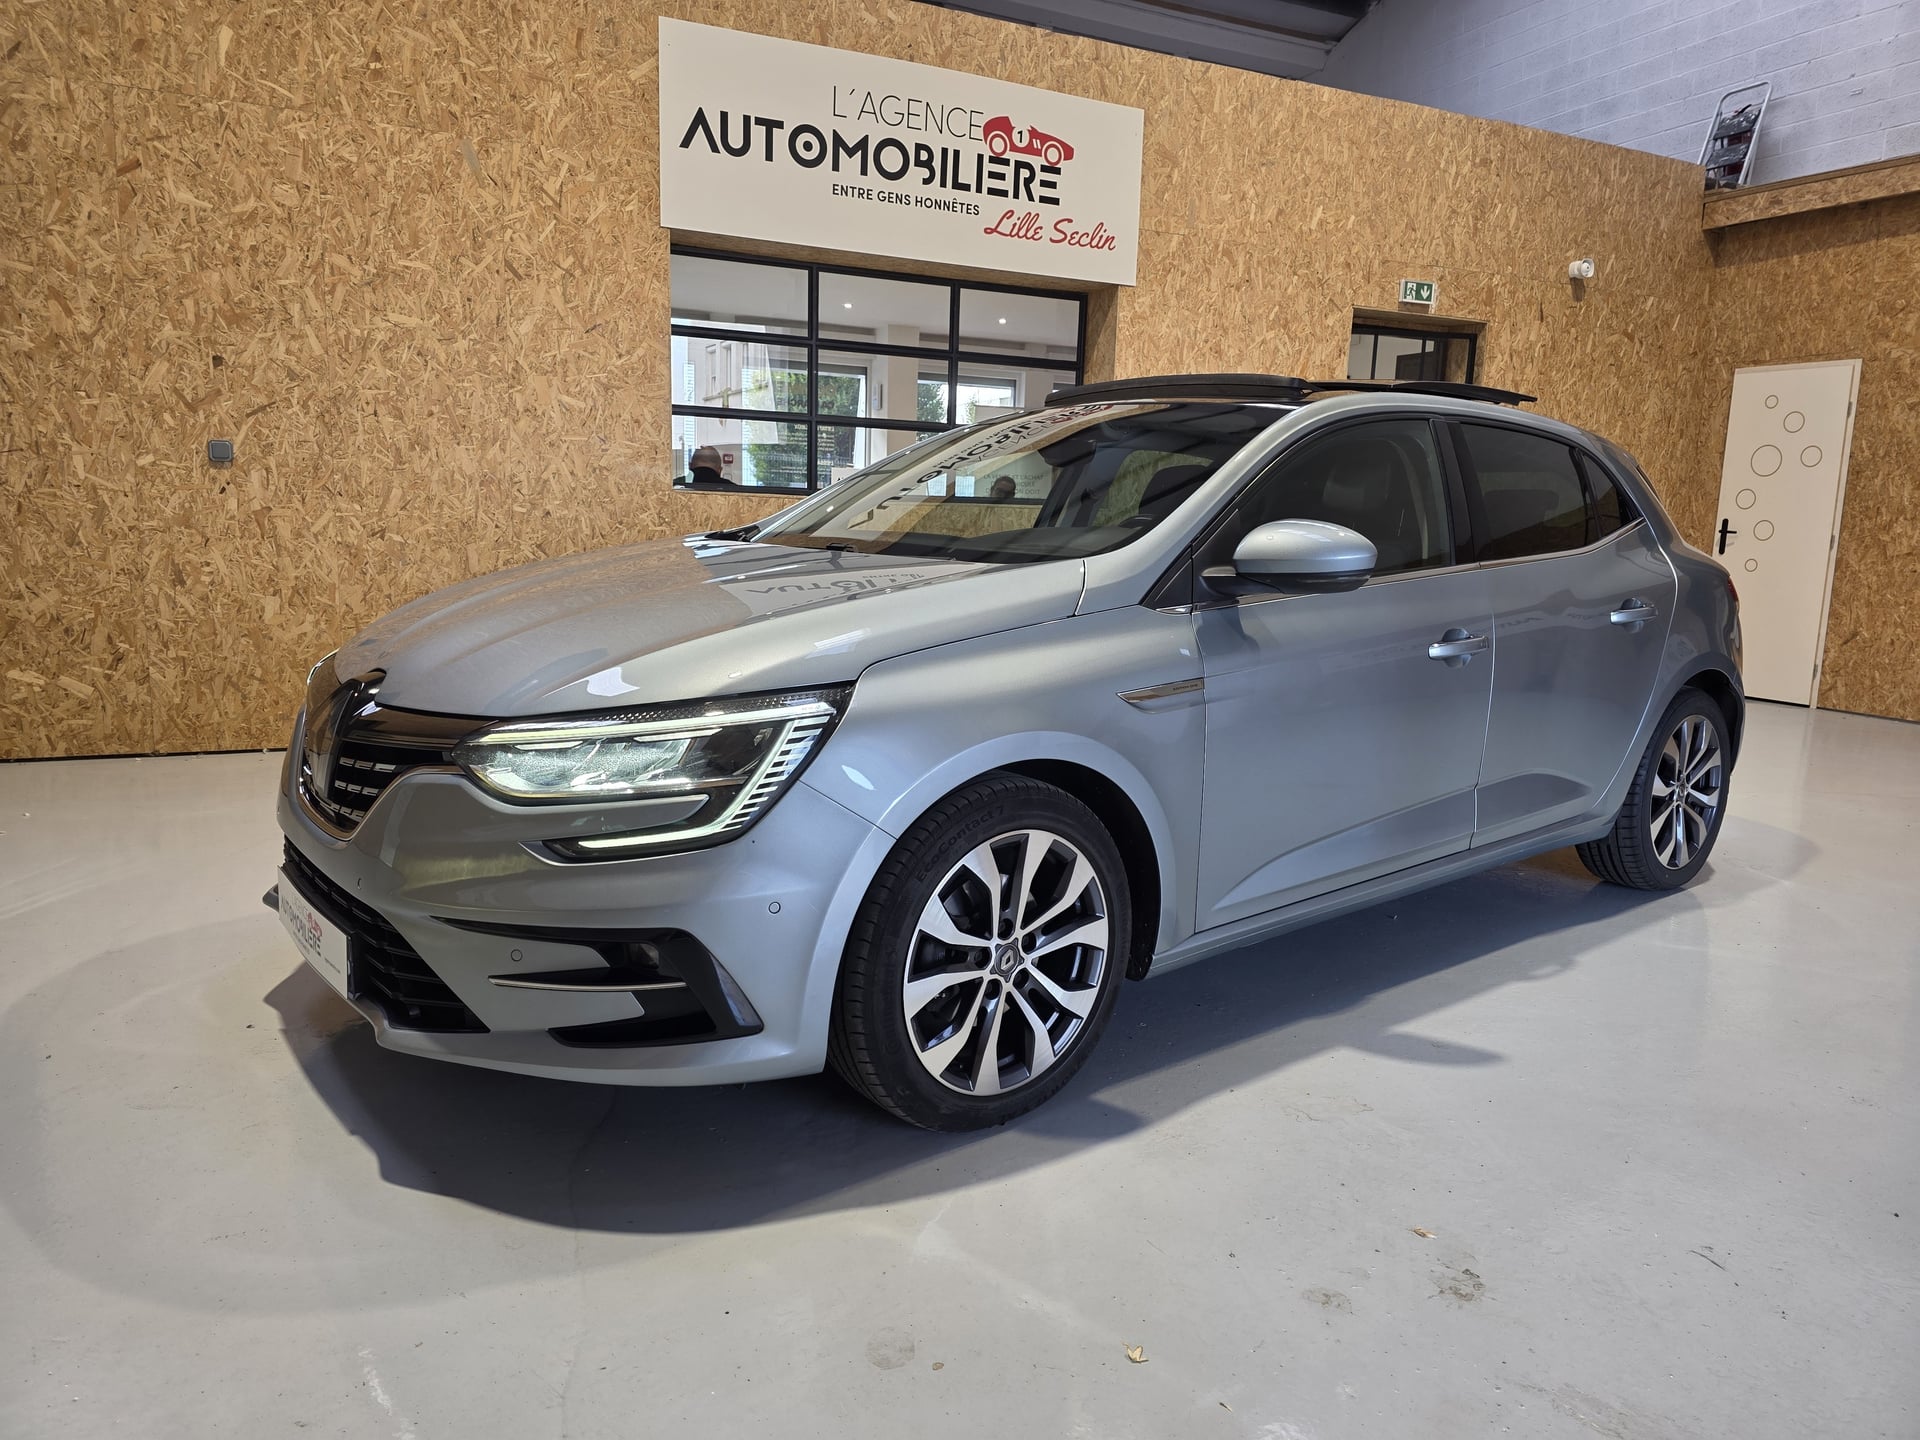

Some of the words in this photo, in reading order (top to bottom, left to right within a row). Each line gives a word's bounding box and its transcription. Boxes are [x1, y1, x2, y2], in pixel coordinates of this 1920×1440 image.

[678, 106, 1062, 206] AUTOMOBILIERE
[832, 183, 873, 200] ENTRE
[877, 190, 911, 206] GENS
[914, 197, 980, 216] HONNÊTES
[983, 209, 1043, 241] Lille
[1049, 217, 1117, 251] Seclin
